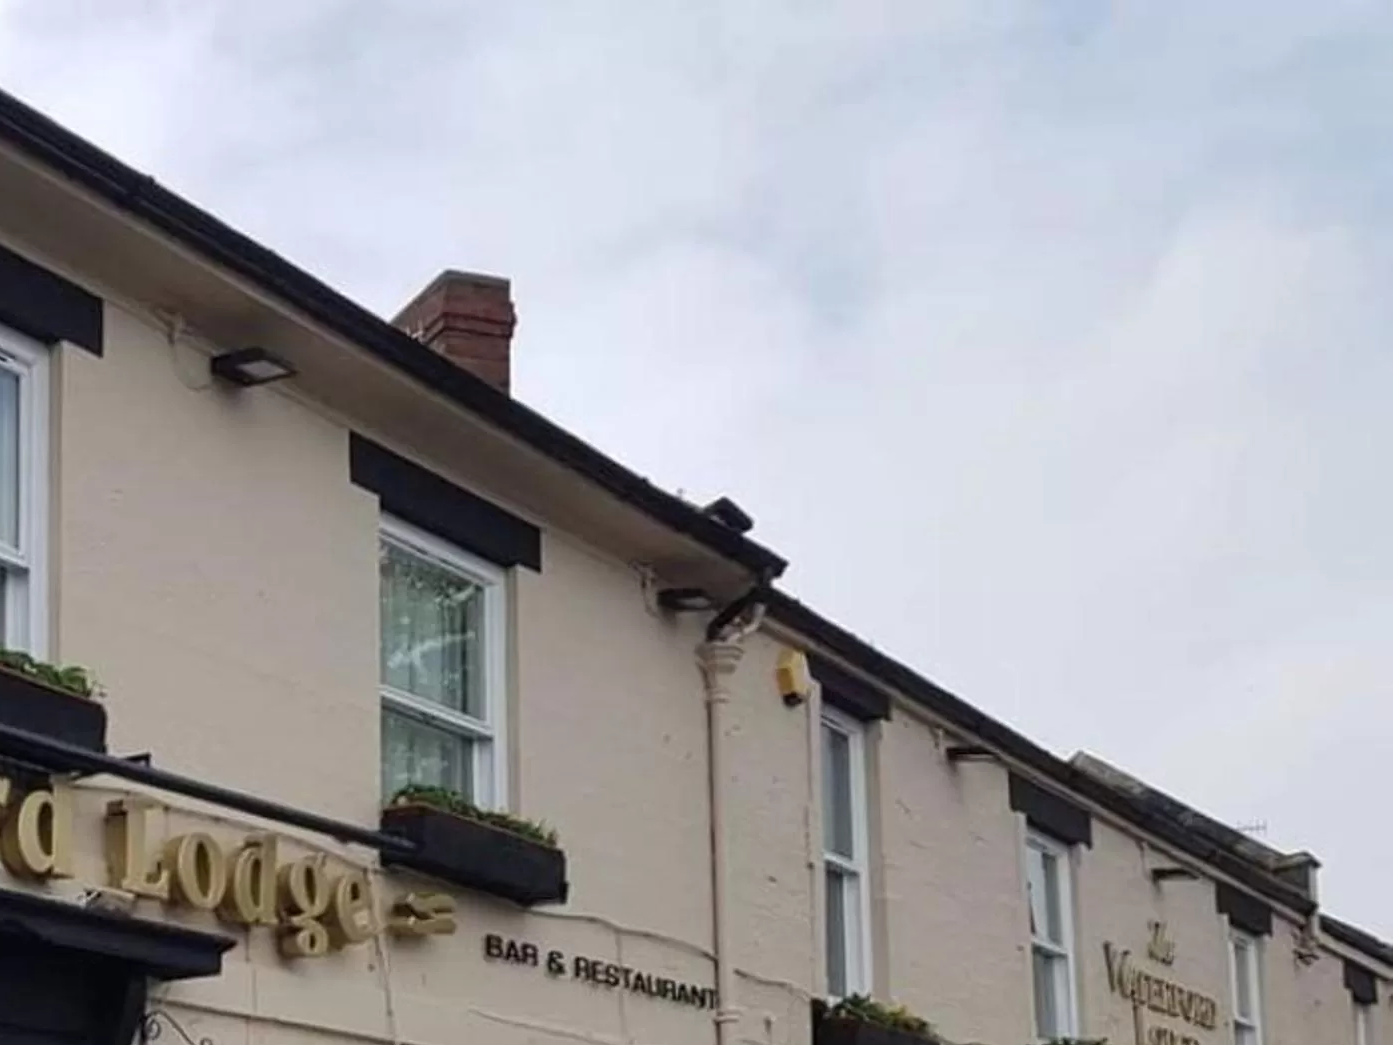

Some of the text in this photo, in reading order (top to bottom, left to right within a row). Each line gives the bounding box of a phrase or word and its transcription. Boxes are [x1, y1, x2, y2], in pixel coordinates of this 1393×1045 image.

[109, 798, 385, 958] Lodge
[484, 934, 718, 1010] BAR & RESTAURANT
